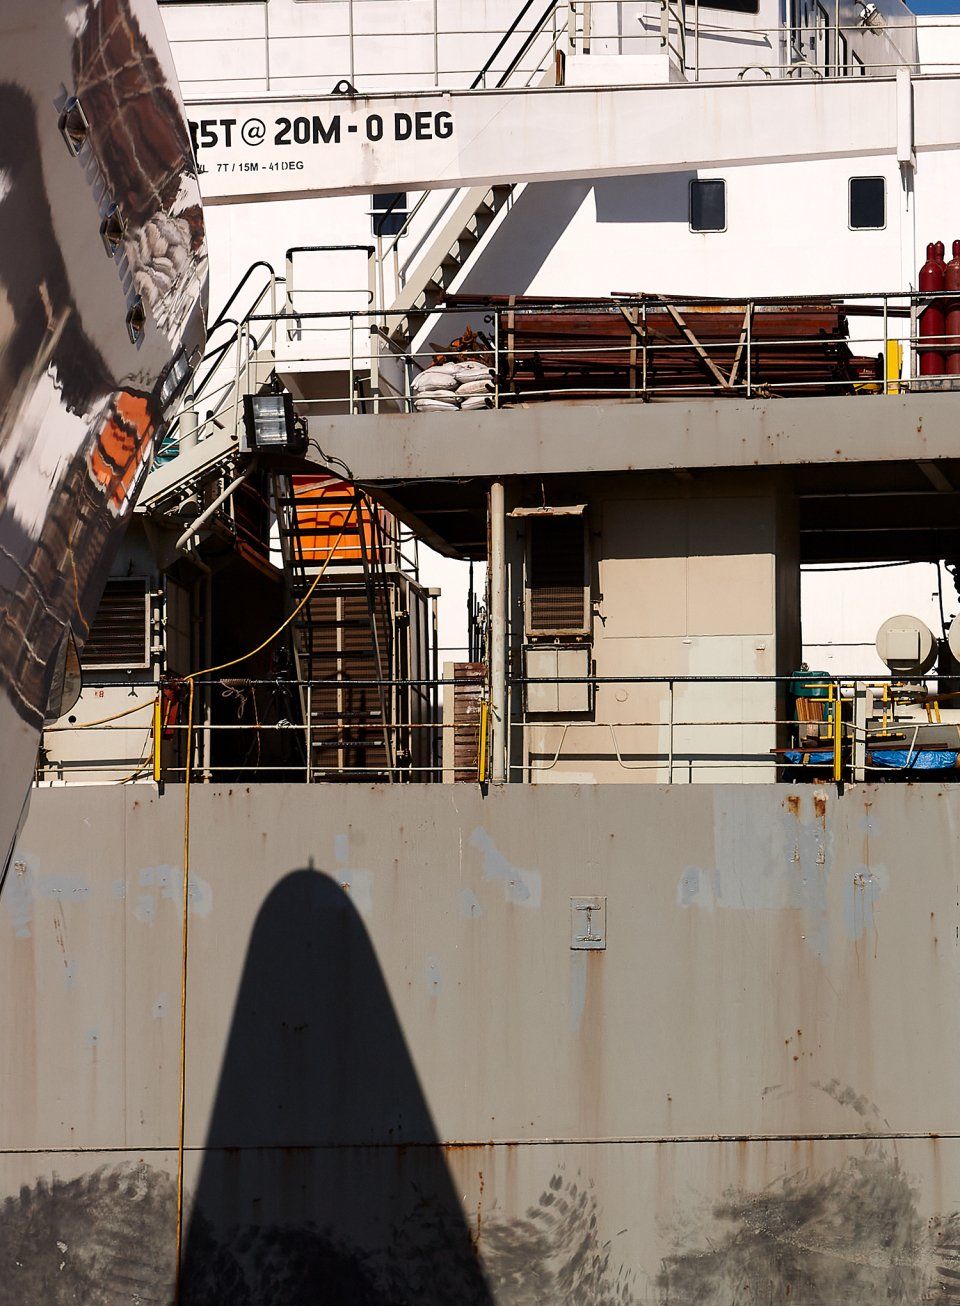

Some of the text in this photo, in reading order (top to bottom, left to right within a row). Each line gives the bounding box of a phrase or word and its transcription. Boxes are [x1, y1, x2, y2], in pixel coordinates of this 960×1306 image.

[274, 115, 341, 146] 20M
[394, 111, 454, 141] DEG
[239, 162, 259, 172] 15M
